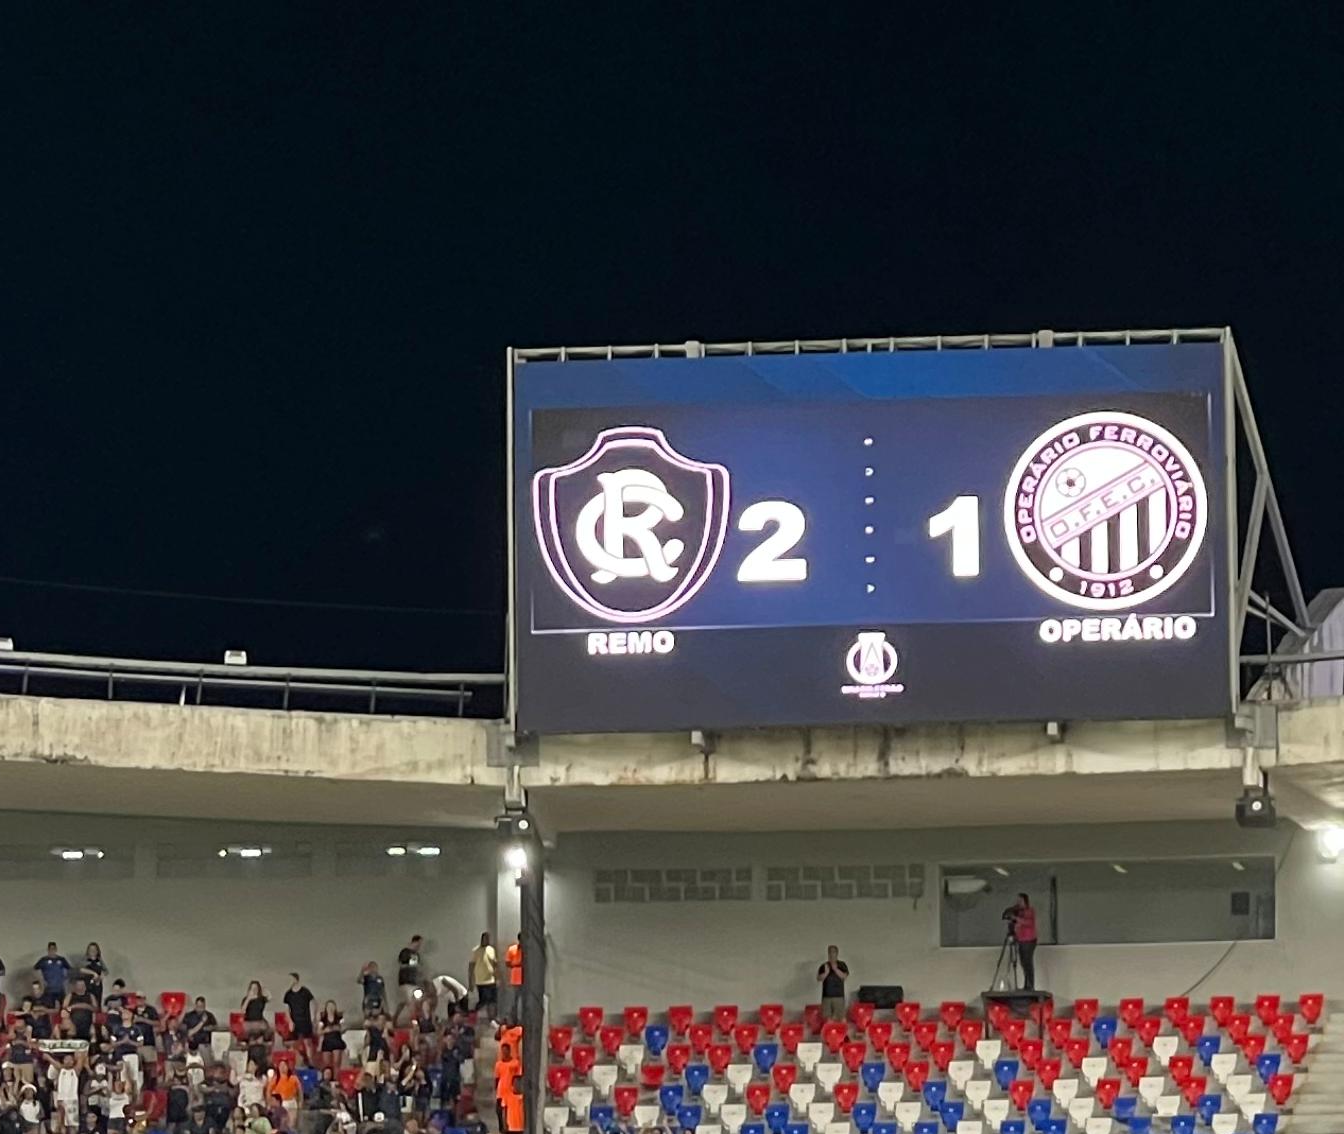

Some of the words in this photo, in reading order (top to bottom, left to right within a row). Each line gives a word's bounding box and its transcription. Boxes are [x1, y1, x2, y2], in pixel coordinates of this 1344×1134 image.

[737, 500, 807, 582] 2
[929, 496, 980, 576] 1
[1079, 579, 1135, 598] 1912
[587, 630, 675, 655] REMO
[1039, 613, 1197, 643] OPERÁRIO
